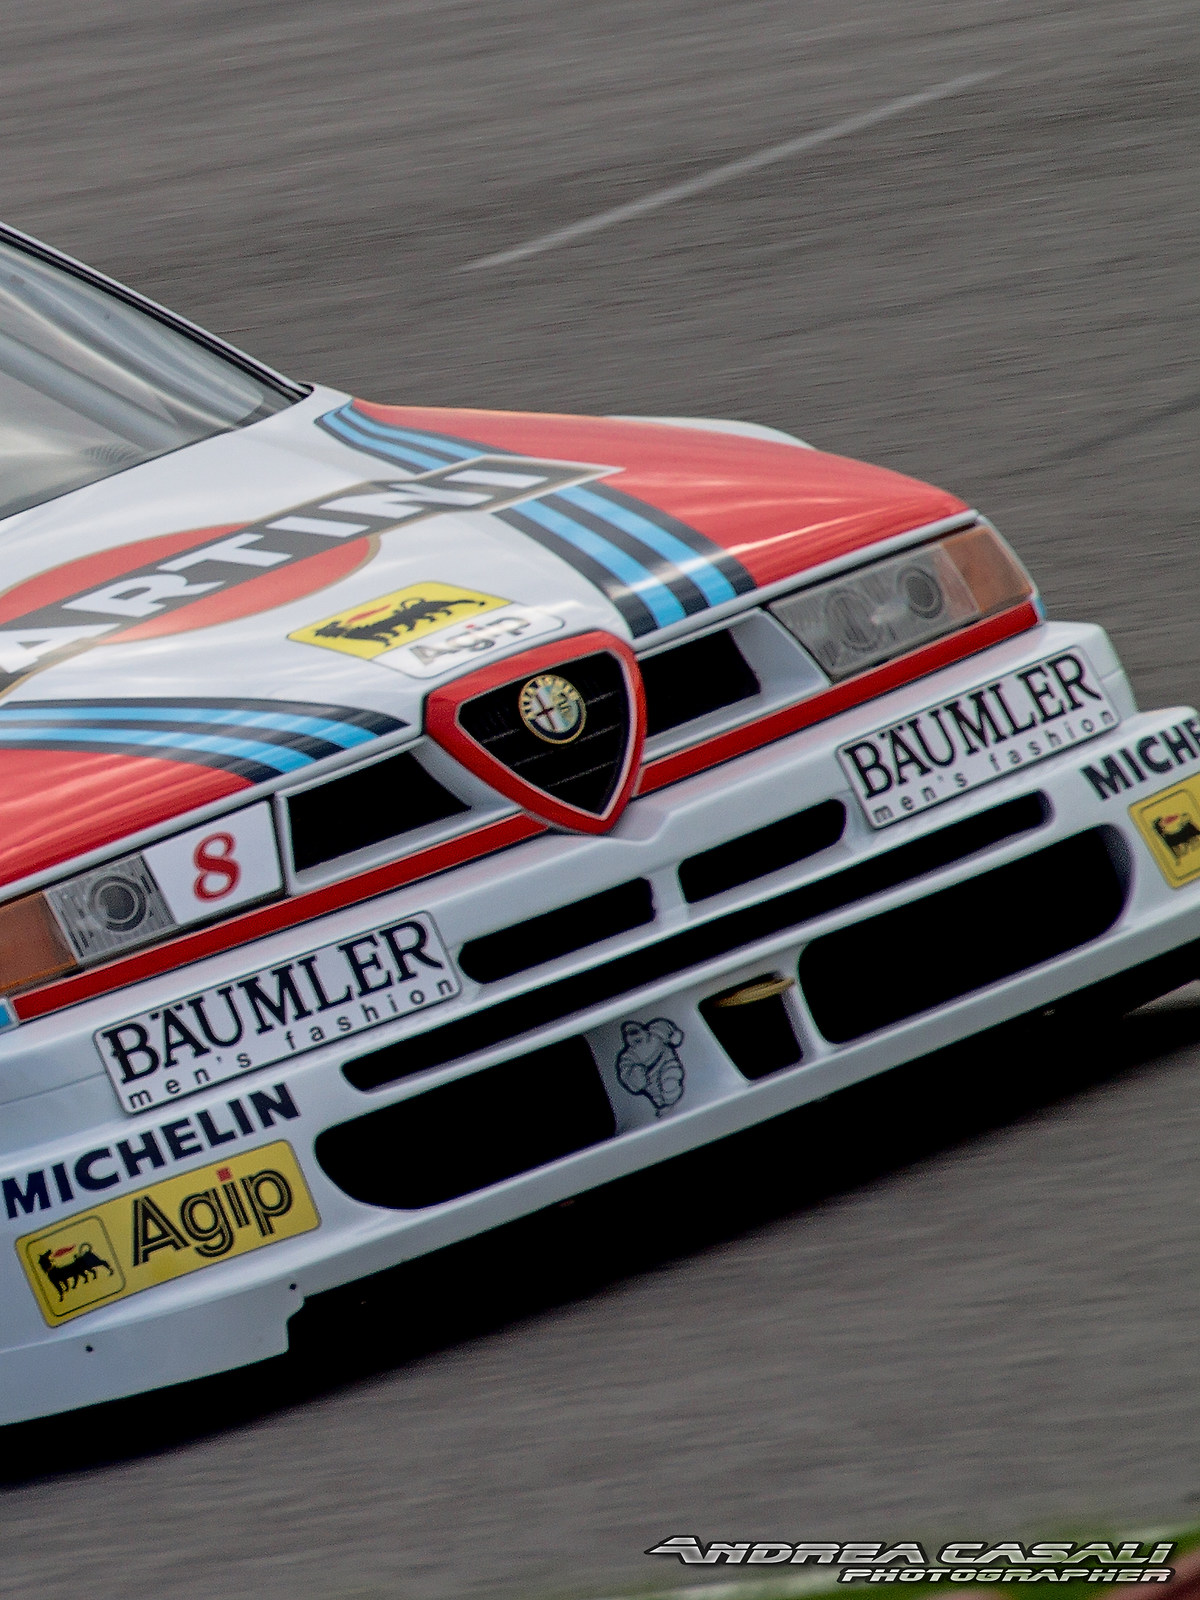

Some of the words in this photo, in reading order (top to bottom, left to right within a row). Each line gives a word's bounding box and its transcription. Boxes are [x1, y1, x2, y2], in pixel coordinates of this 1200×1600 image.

[844, 653, 1102, 799] BÄUMLER
[873, 772, 968, 824] men's
[989, 709, 1114, 772] fashion
[192, 831, 241, 903] 8
[102, 920, 443, 1085] BÄUMLER
[128, 1053, 252, 1110] men's
[284, 977, 455, 1051] fashion
[1, 1083, 301, 1220] MICHELIN
[130, 1165, 295, 1268] Agip
